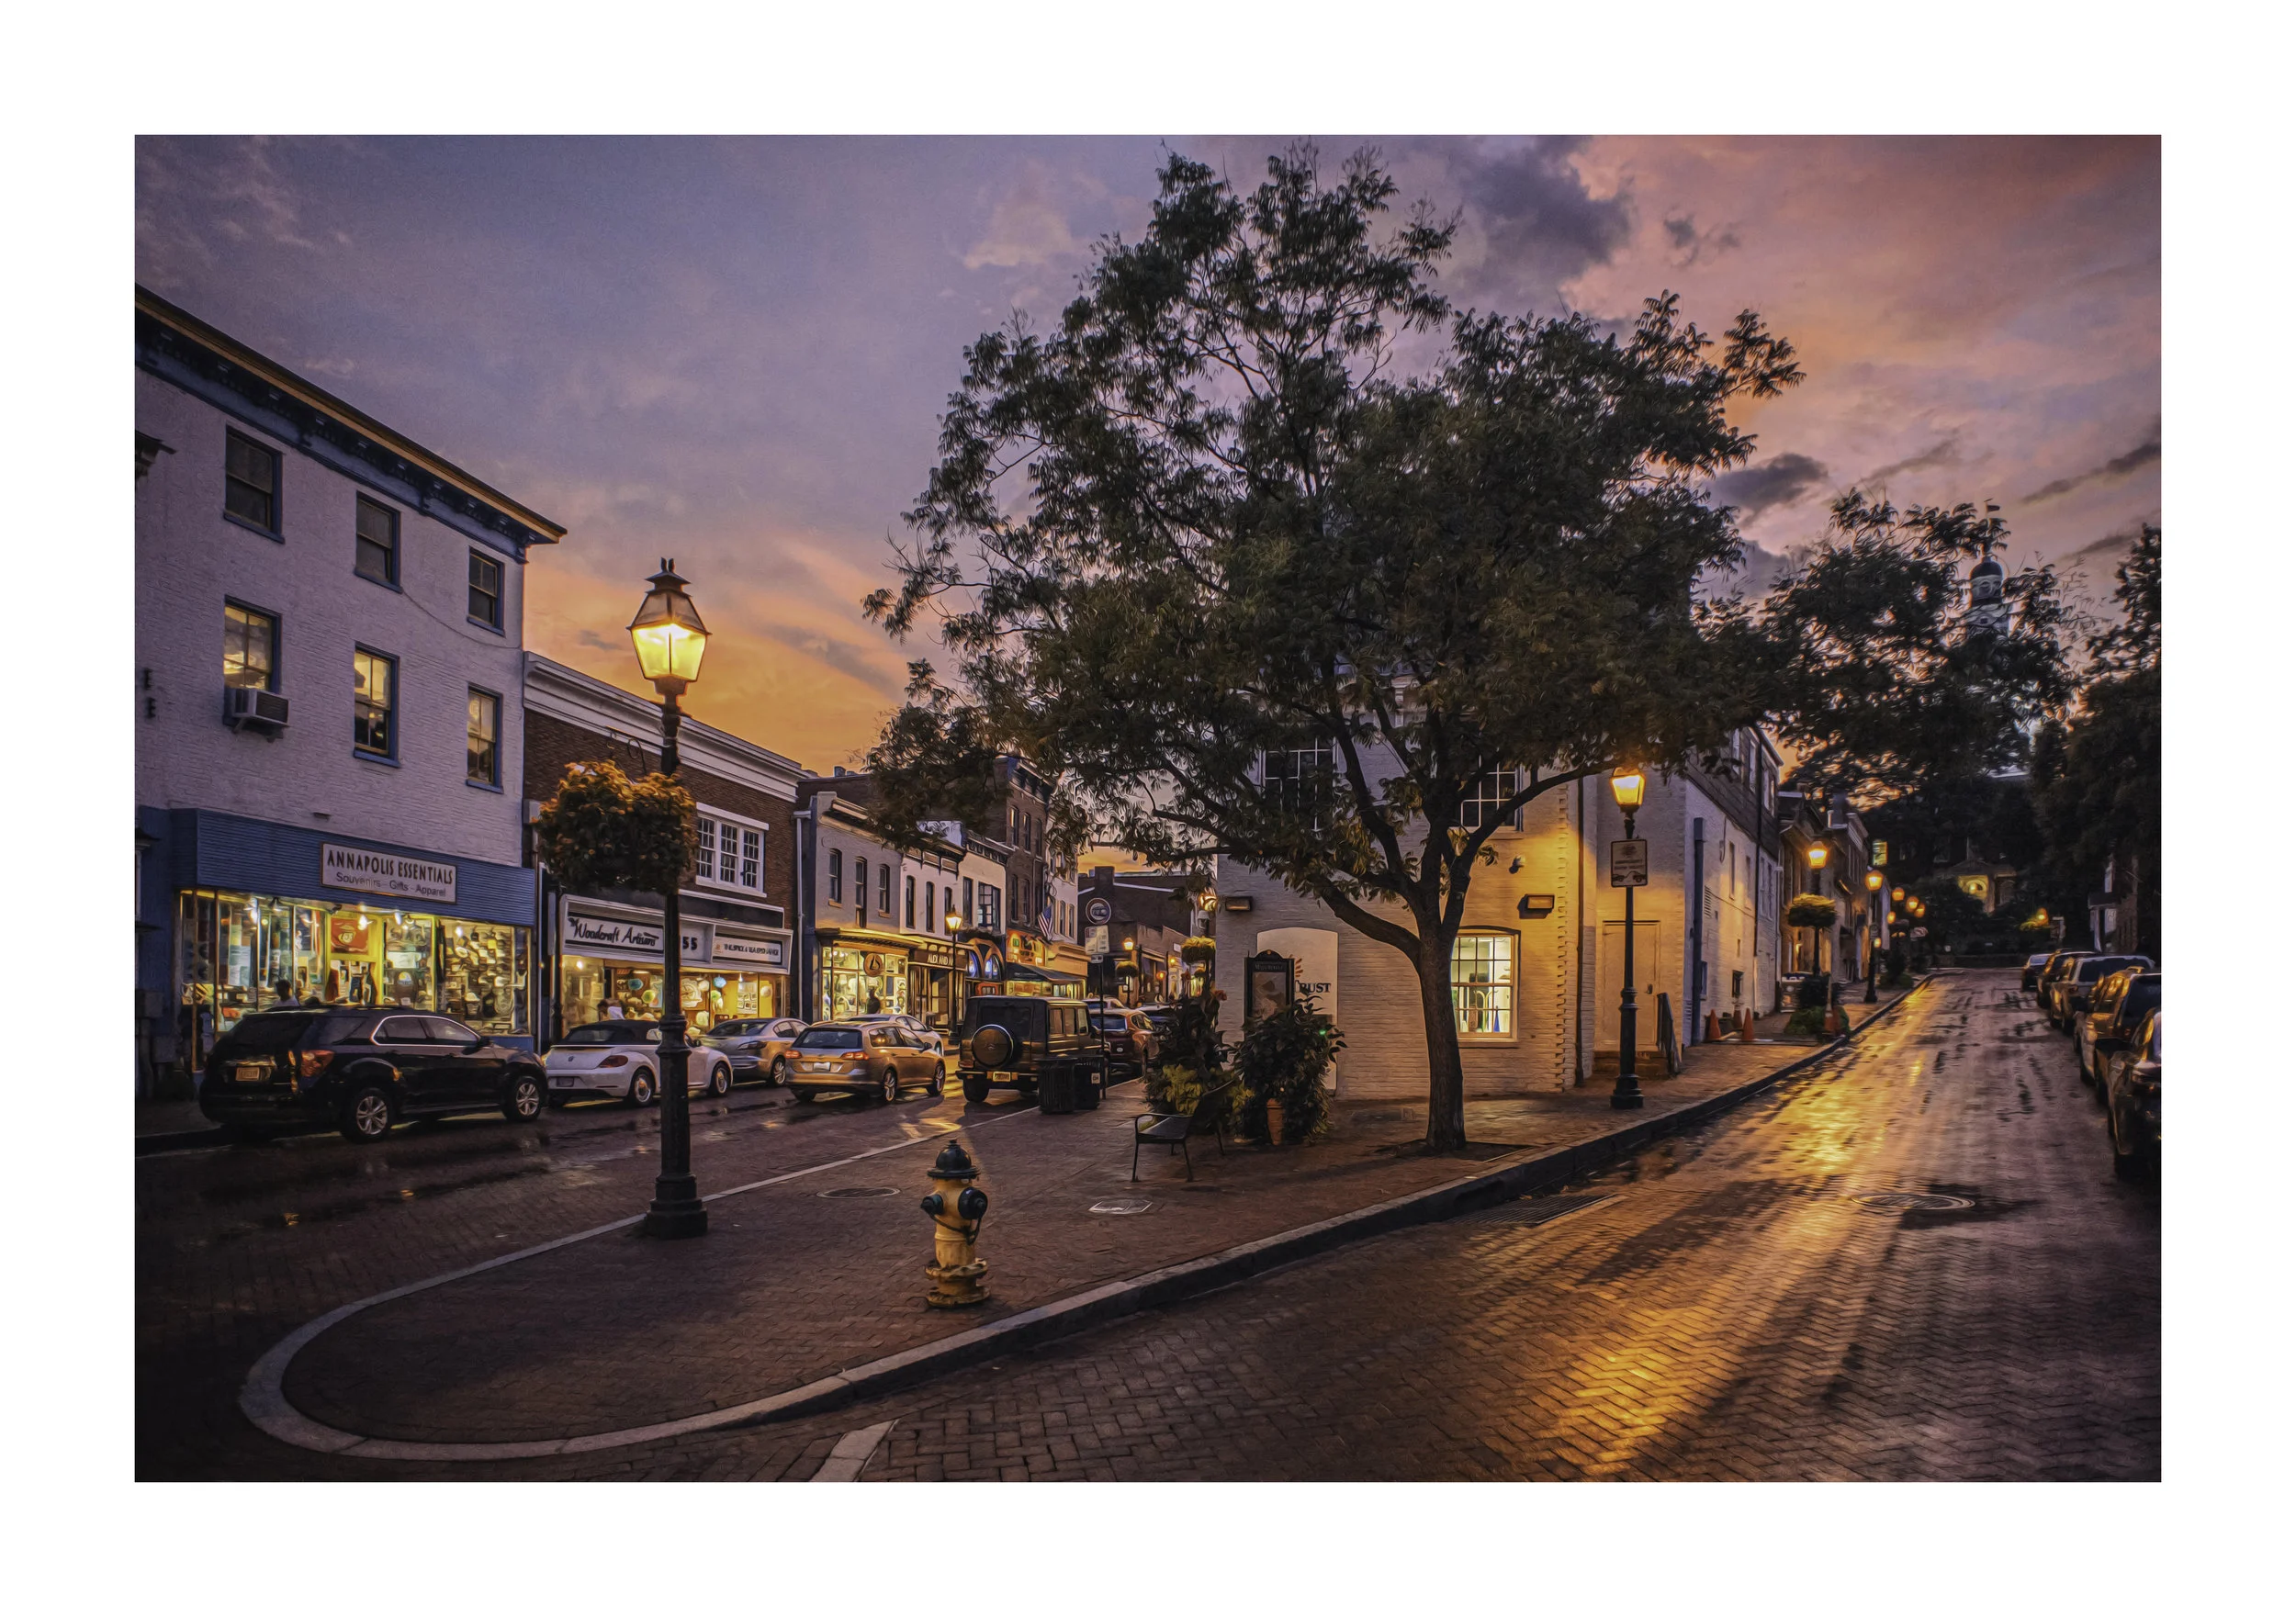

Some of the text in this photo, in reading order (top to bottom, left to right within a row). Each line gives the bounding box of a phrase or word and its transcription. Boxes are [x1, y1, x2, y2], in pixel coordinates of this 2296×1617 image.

[327, 849, 453, 884] ANNAPOLIS ESSENTIALS
[336, 871, 446, 897] Souvenirs Gifts Apparel
